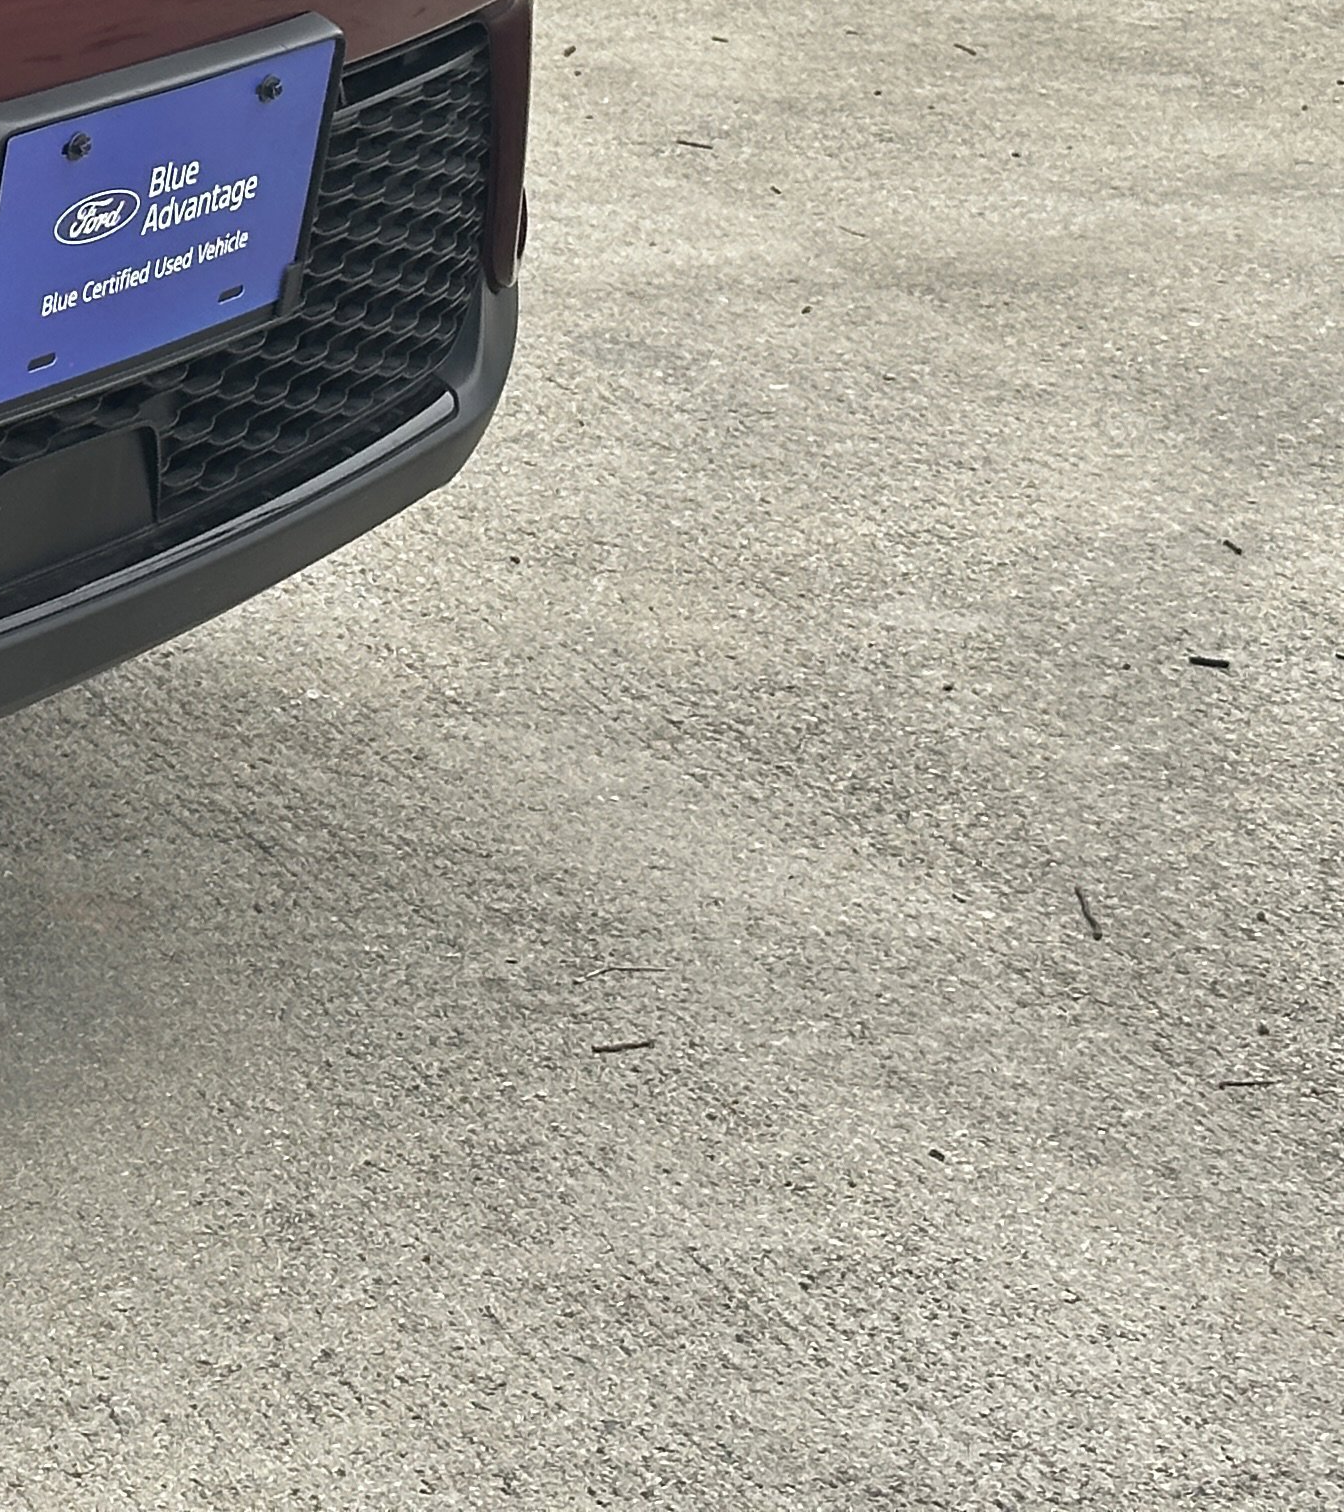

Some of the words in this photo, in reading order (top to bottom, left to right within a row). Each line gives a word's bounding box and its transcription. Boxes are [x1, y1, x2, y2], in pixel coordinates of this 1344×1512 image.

[140, 174, 258, 236] Advantage
[148, 160, 200, 198] Blue
[69, 197, 126, 239] Ford
[40, 292, 78, 317] Blue
[82, 261, 152, 303] Certified
[154, 245, 194, 279] Used
[197, 229, 249, 264] Vehicle
